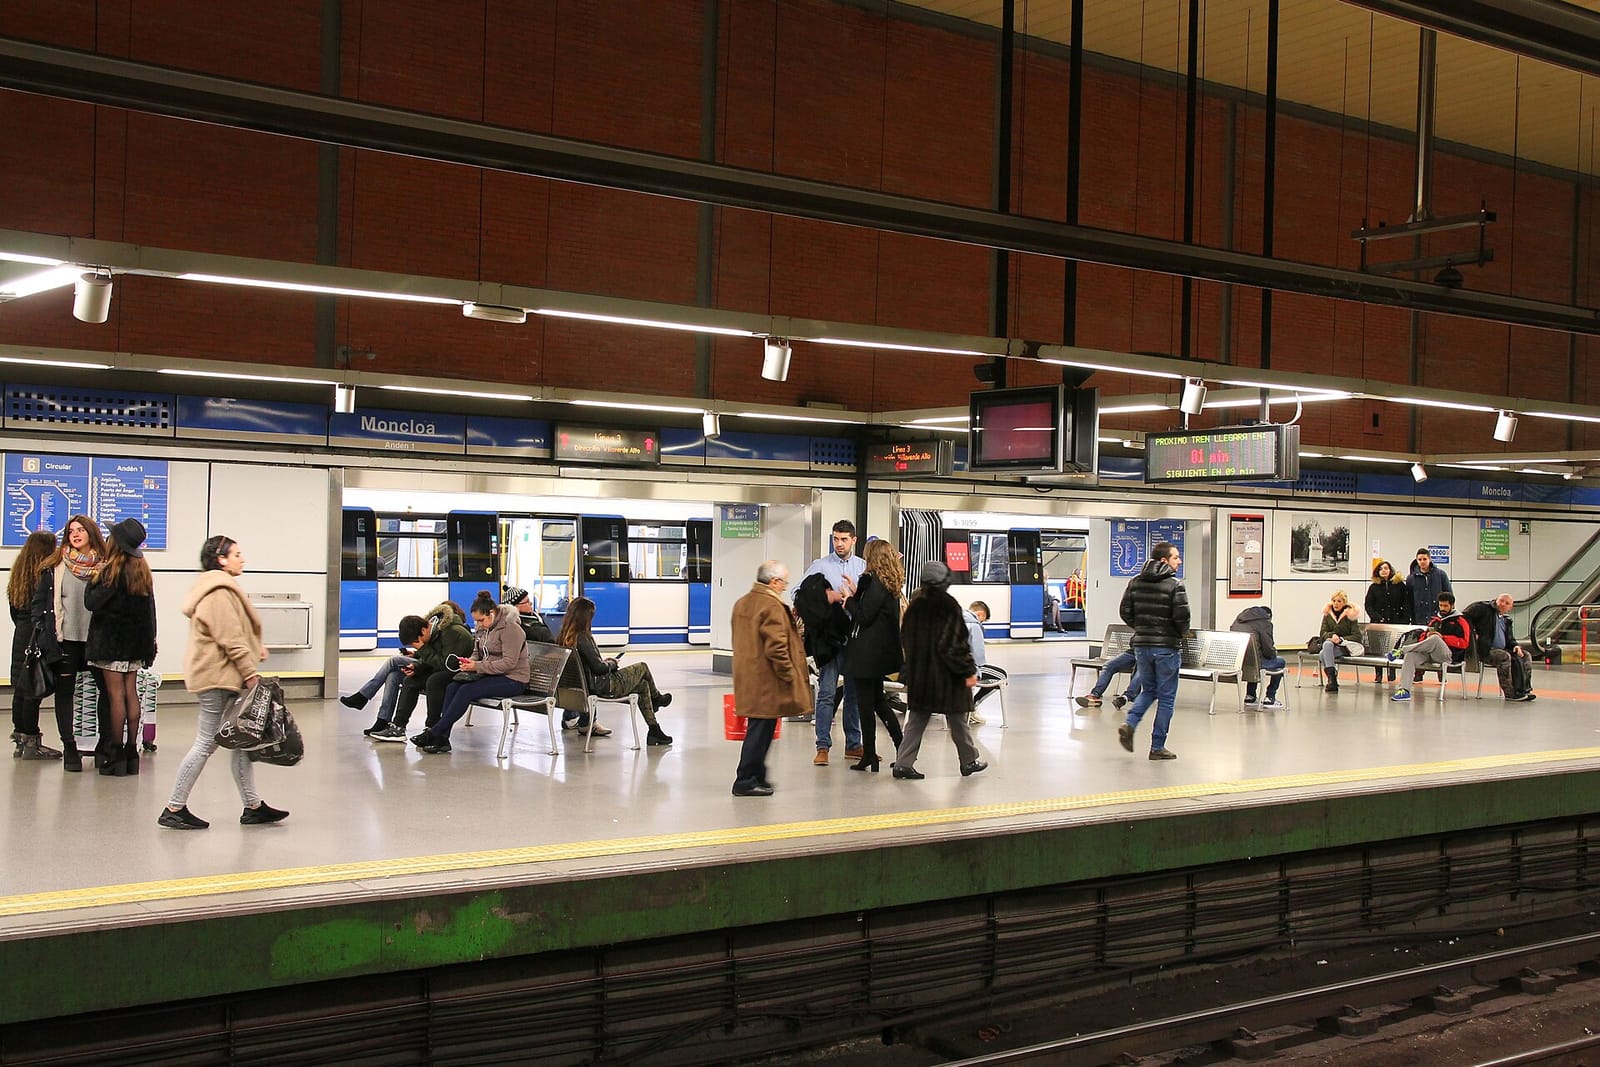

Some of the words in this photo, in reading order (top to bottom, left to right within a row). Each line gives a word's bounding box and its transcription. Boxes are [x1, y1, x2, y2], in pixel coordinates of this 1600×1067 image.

[361, 416, 435, 434] Moncloa
[616, 433, 622, 441] 3
[1155, 437, 1188, 445] PROXIMO
[1191, 435, 1210, 444] TREN
[1214, 433, 1248, 443] LLEGARA
[906, 445, 911, 453] 3
[1209, 451, 1230, 463] min
[27, 459, 37, 471] 6
[1166, 469, 1207, 478] SIGUIENTE
[1482, 486, 1511, 496] Moncloa
